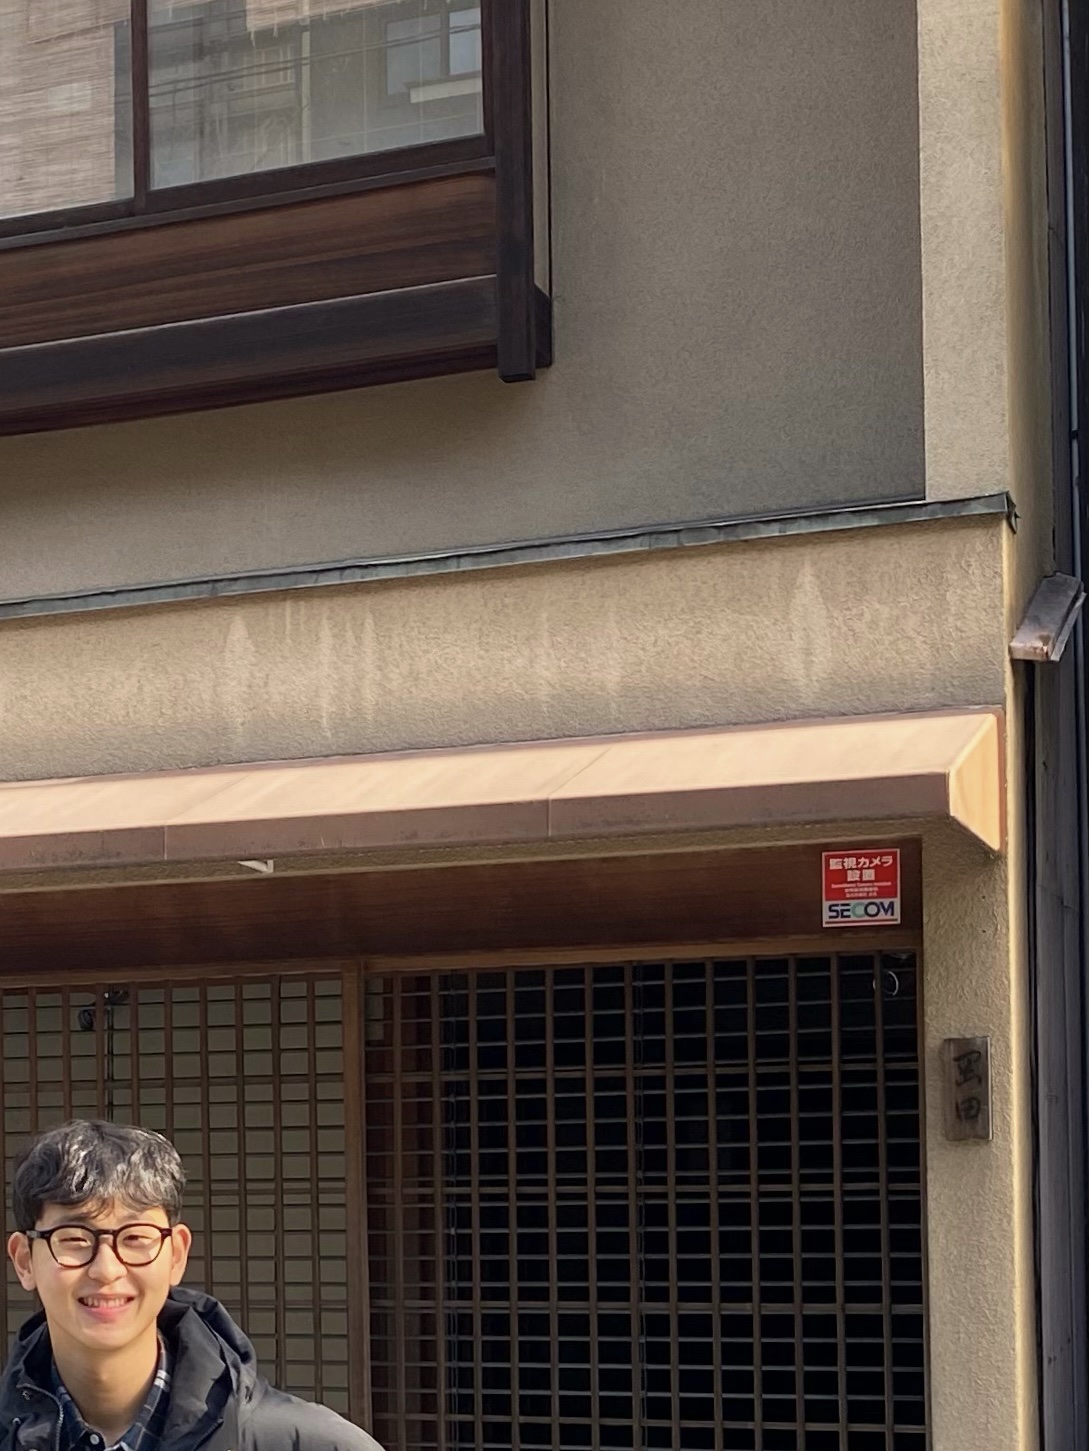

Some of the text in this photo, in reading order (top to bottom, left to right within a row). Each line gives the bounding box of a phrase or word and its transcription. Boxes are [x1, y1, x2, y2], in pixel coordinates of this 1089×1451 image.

[829, 856, 893, 870] 監視カメラ
[847, 869, 875, 881] 設置
[828, 901, 894, 919] SECOM
